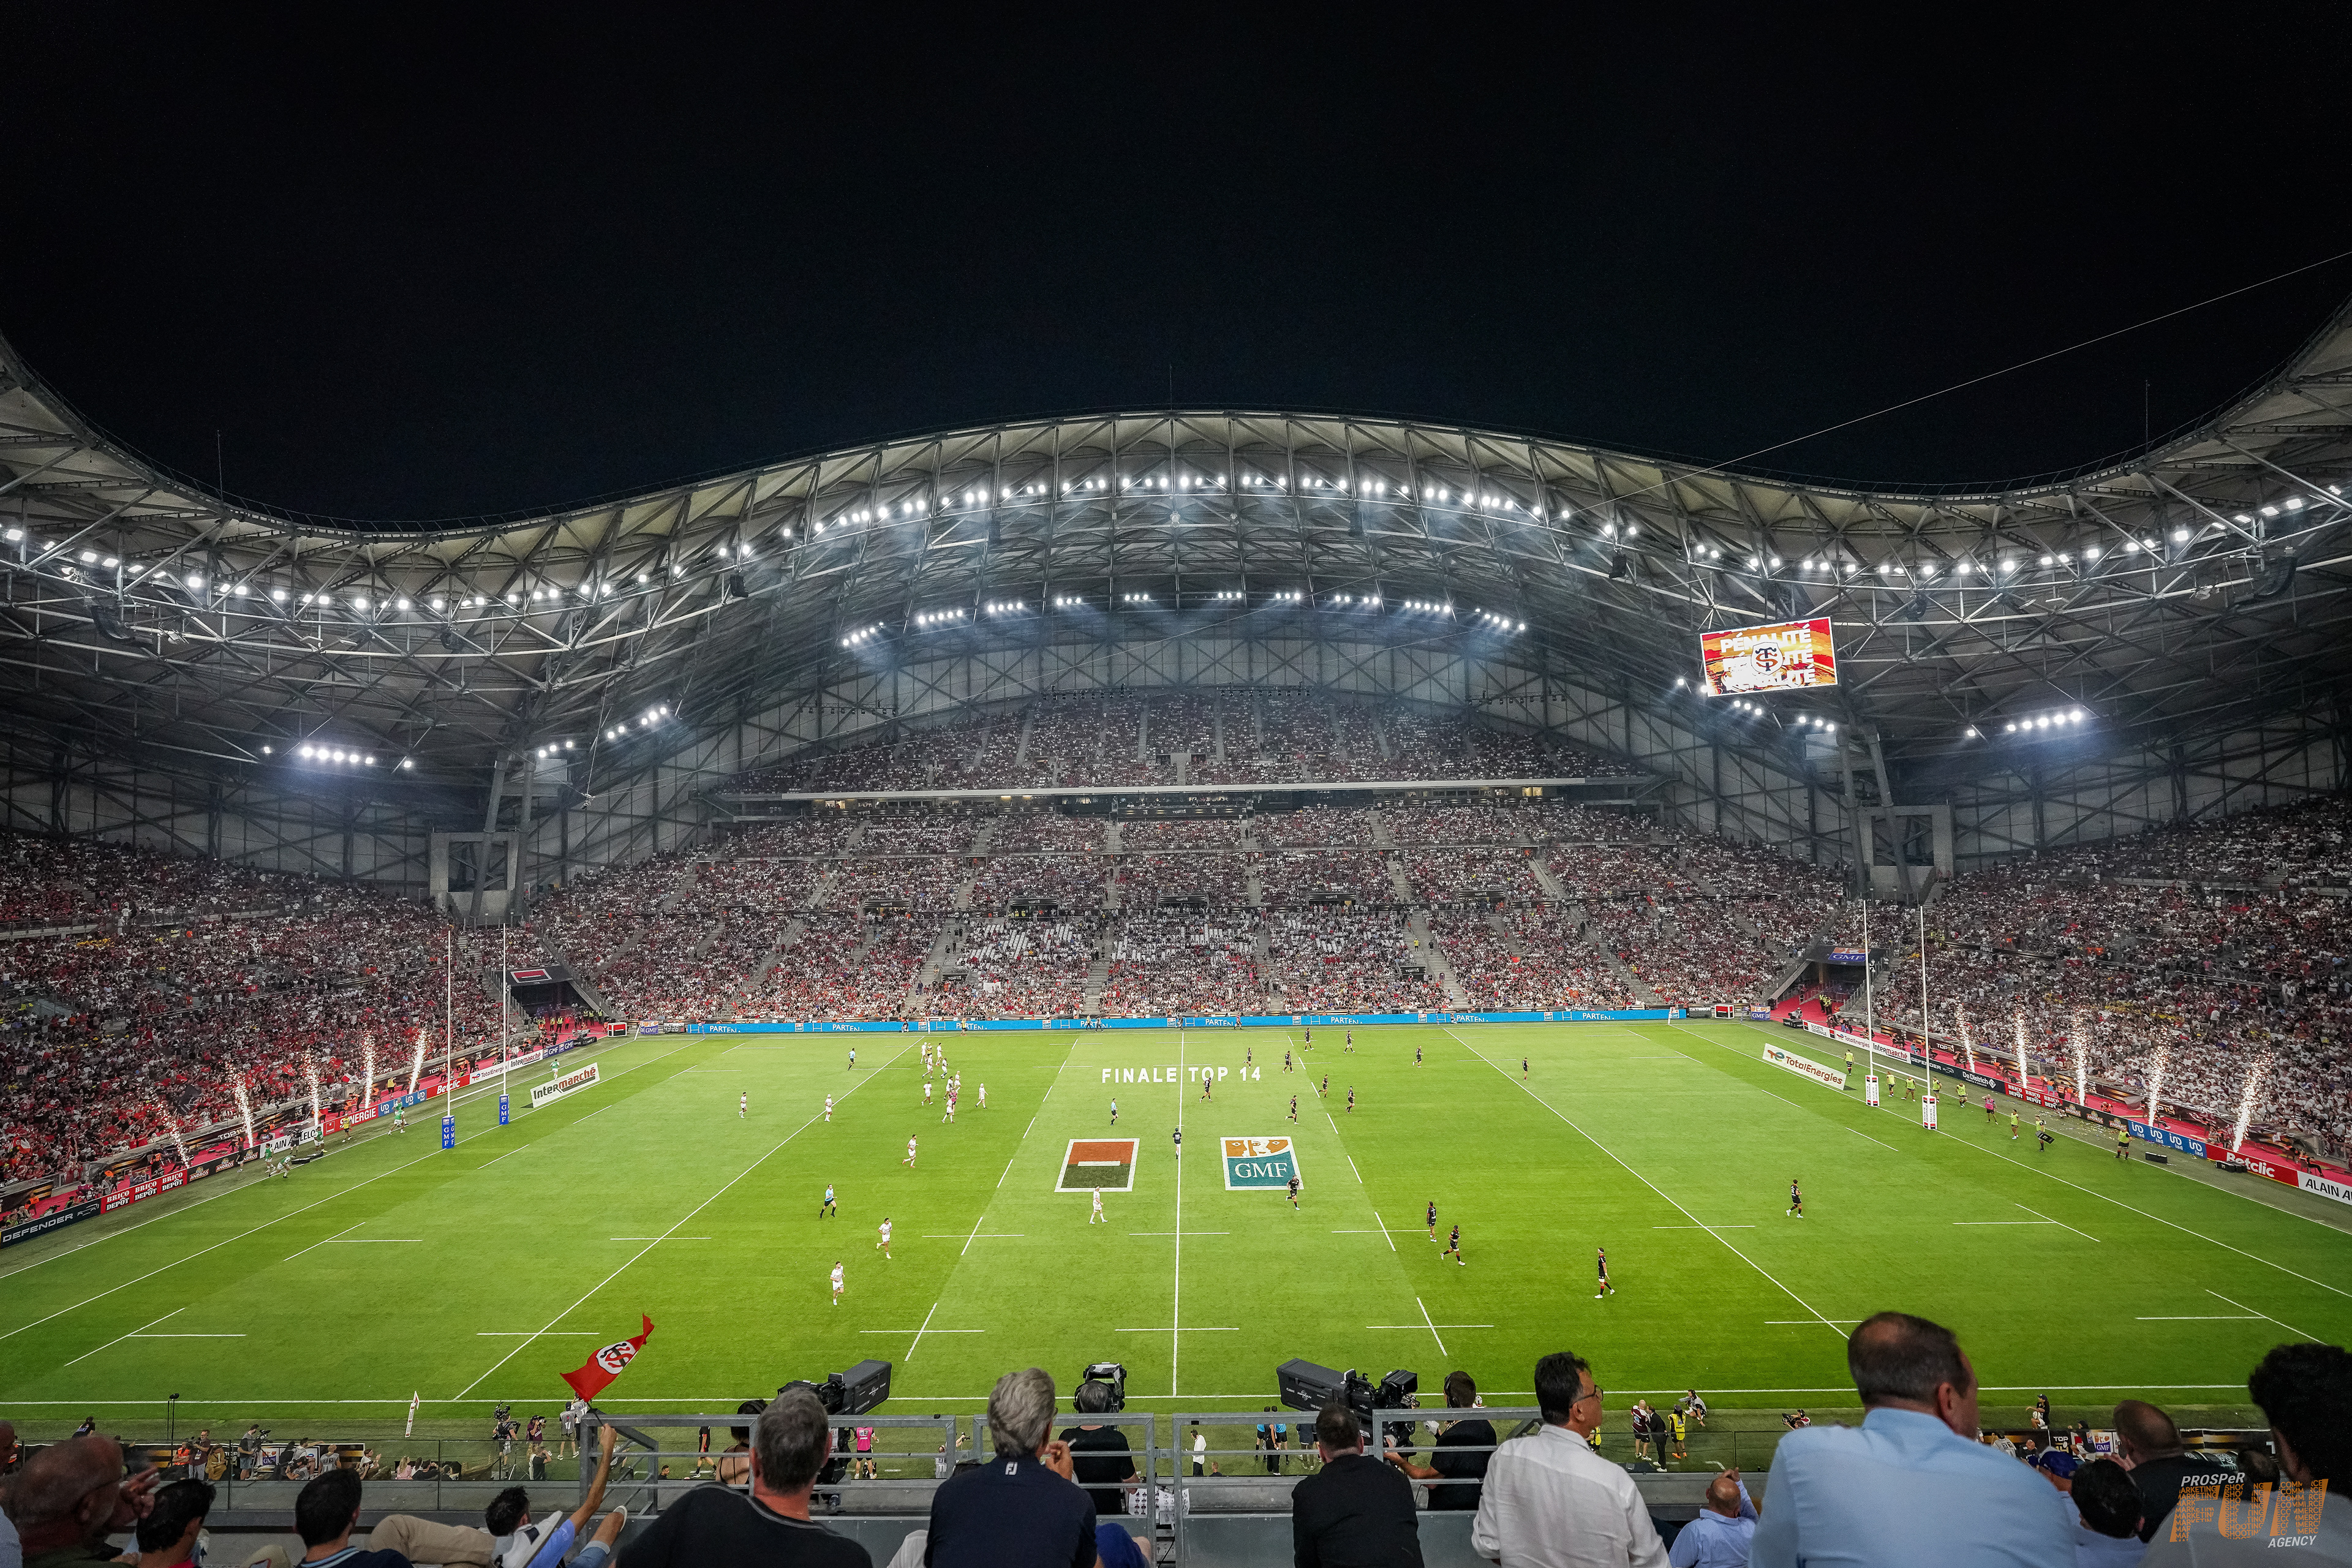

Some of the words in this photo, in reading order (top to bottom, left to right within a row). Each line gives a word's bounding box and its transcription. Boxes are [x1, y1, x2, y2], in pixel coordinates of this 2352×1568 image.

[1873, 1042, 1908, 1060] Intermarché
[510, 1052, 541, 1068] Intermarché
[1912, 1057, 1942, 1071] DEFEDER
[481, 1065, 508, 1078] TotalEnergis
[1102, 1067, 1177, 1084] FINALE
[1188, 1066, 1229, 1082] TOP
[1239, 1066, 1262, 1081] 14
[1786, 1056, 1843, 1085] TotalEnergies
[533, 1067, 596, 1100] Intermarché
[2008, 1084, 2022, 1092] BRICO
[2025, 1090, 2041, 1098] BRICO
[339, 1107, 377, 1128] SNERGIE
[215, 1161, 234, 1172] ANDROS
[1234, 1163, 1287, 1178] GMF
[2226, 1152, 2275, 1178] Betclic
[162, 1171, 184, 1184] BRICO
[189, 1169, 209, 1181] ANDROS
[135, 1180, 157, 1193] BRICO
[161, 1179, 184, 1192] DEPÔT
[2305, 1178, 2341, 1199] ALAIN
[107, 1189, 130, 1203] BRICO
[134, 1188, 158, 1201] DEPÔT
[106, 1198, 130, 1212] DEPÔT
[2, 1213, 74, 1243] DEFENDER
